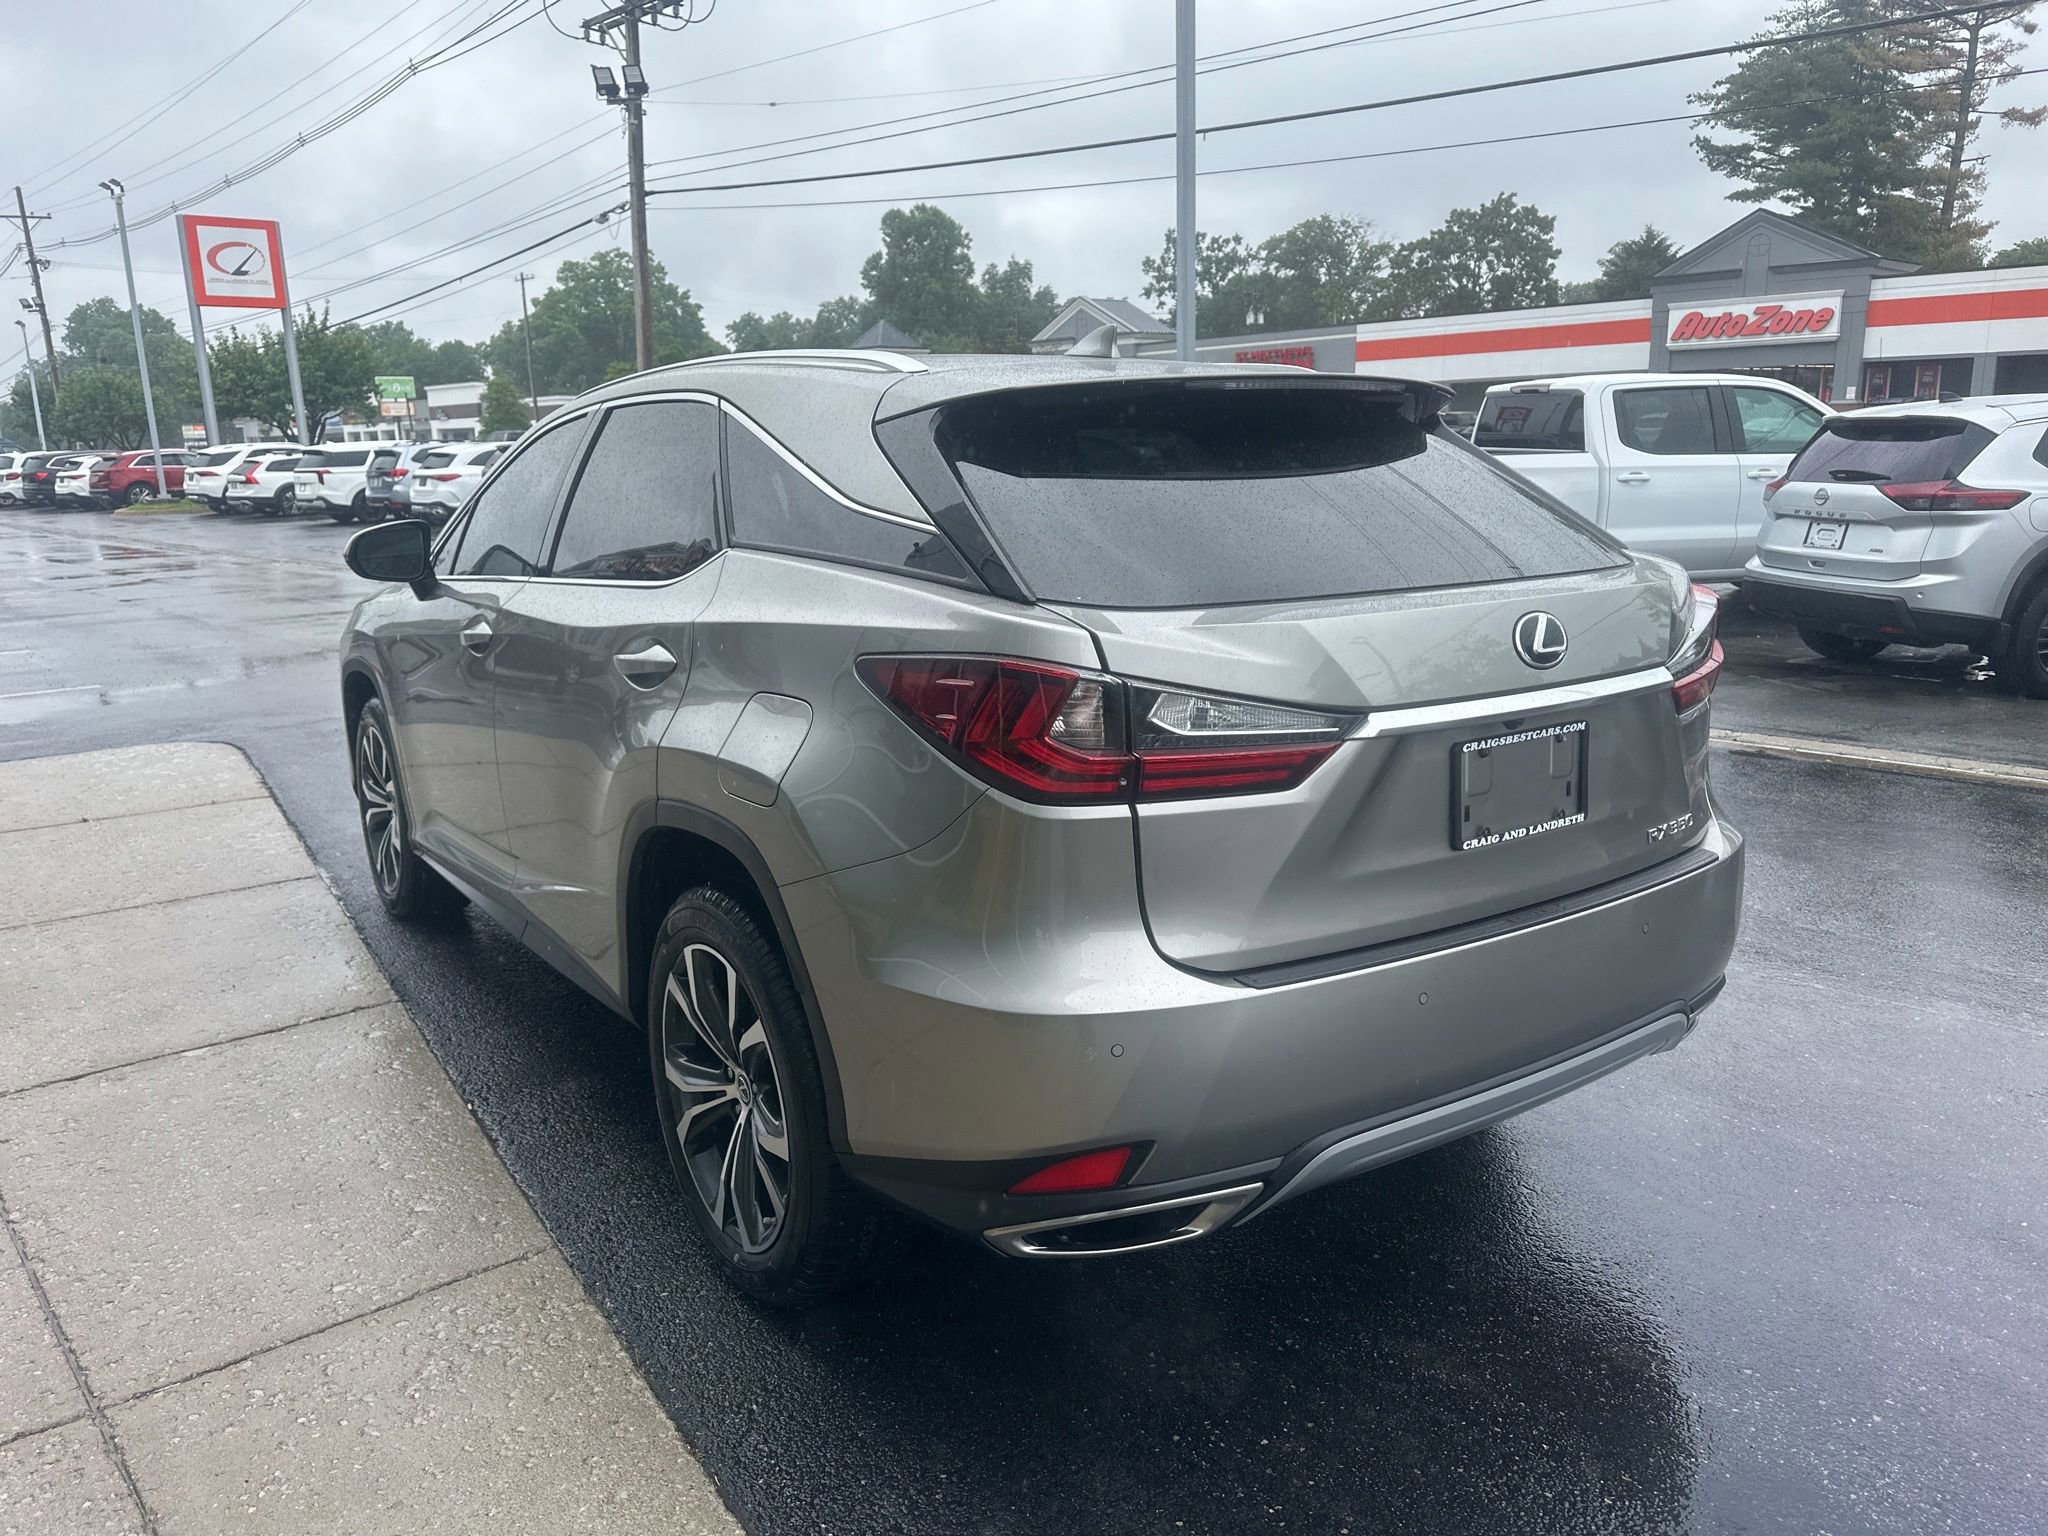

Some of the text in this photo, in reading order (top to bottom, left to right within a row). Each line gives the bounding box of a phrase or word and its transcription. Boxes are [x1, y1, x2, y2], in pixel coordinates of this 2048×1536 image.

[1670, 304, 1835, 341] AutoZone
[1793, 509, 1847, 518] ROGUE
[1462, 721, 1586, 753] CRAIGSBESTCARS.COM
[1462, 813, 1585, 850] CRAIG AND LANDRETH
